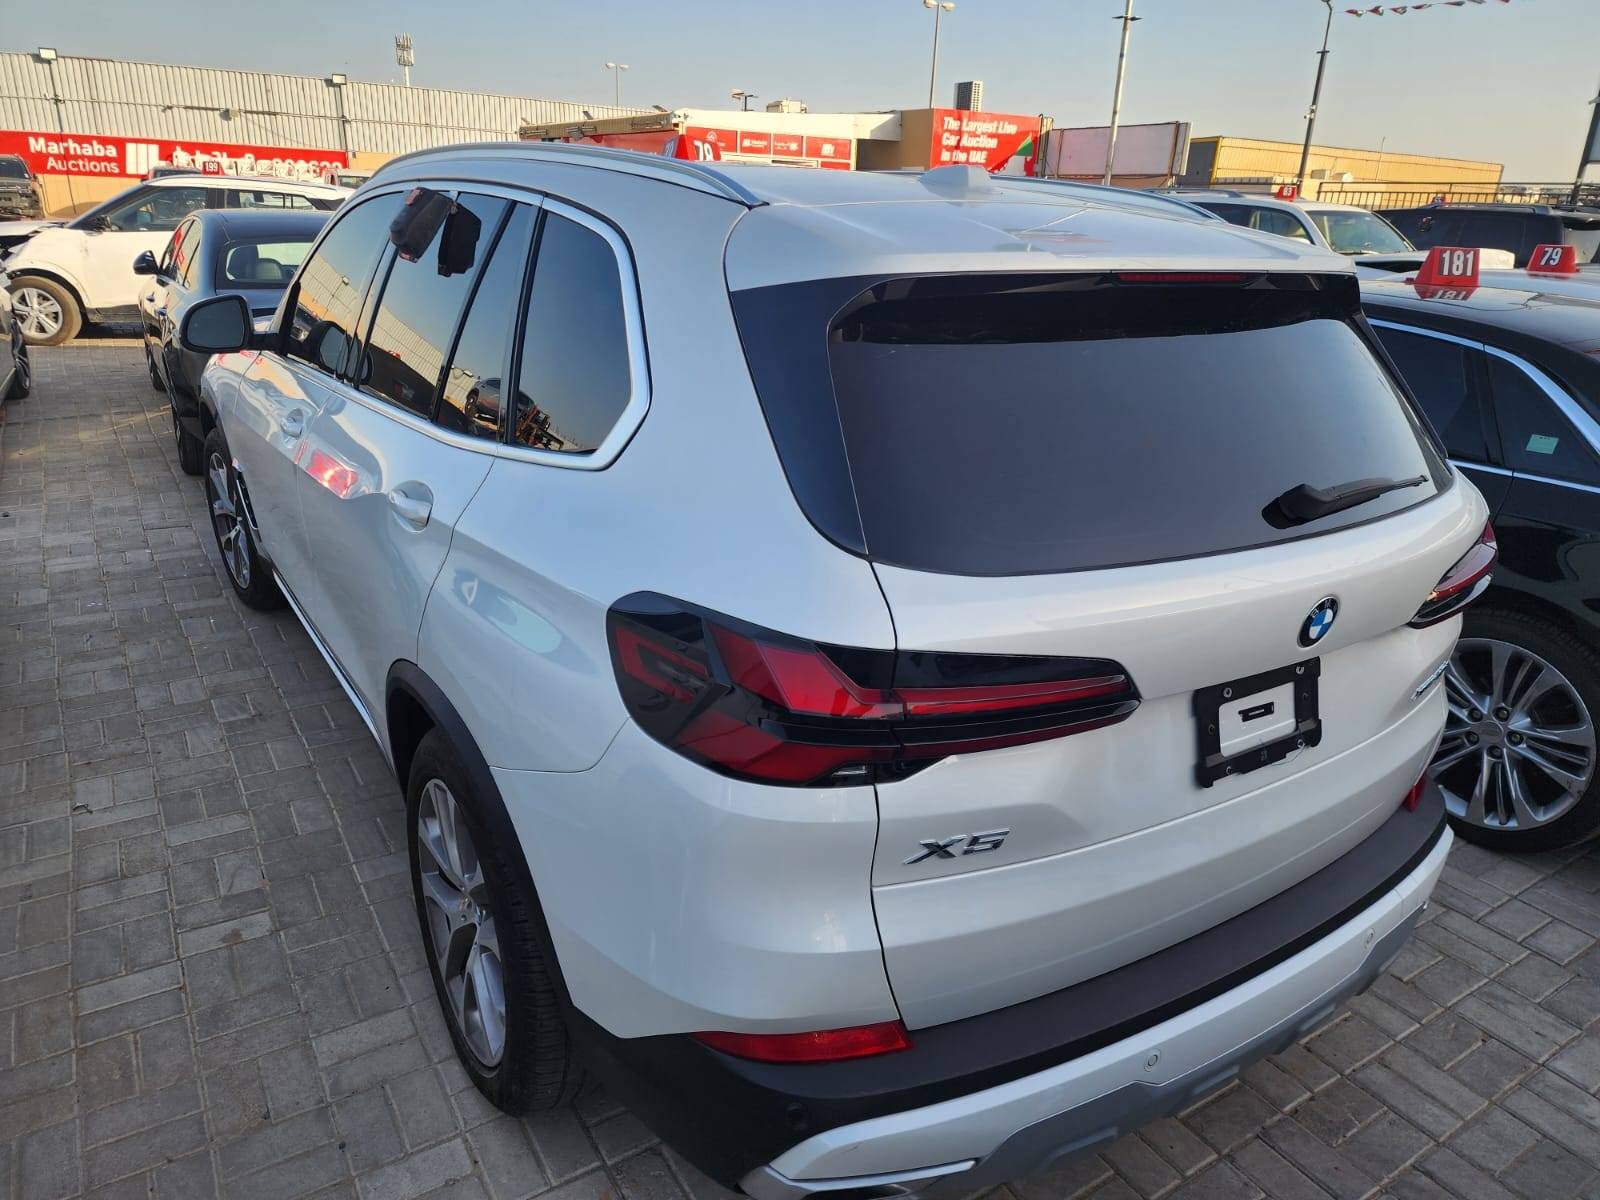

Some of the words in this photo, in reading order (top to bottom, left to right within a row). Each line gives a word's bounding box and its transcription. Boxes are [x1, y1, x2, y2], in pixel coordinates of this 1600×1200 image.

[943, 117, 960, 130] The
[962, 118, 997, 135] Largest
[998, 121, 1018, 135] Live
[28, 136, 117, 157] Marhaba
[942, 132, 960, 146] Car
[960, 133, 998, 149] Auction
[47, 157, 120, 173] Auctions
[941, 149, 951, 162] in
[952, 149, 967, 162] the
[969, 150, 989, 163] UAE
[1442, 250, 1474, 277] 181
[1539, 248, 1563, 266] 79
[903, 827, 1011, 865] X5
